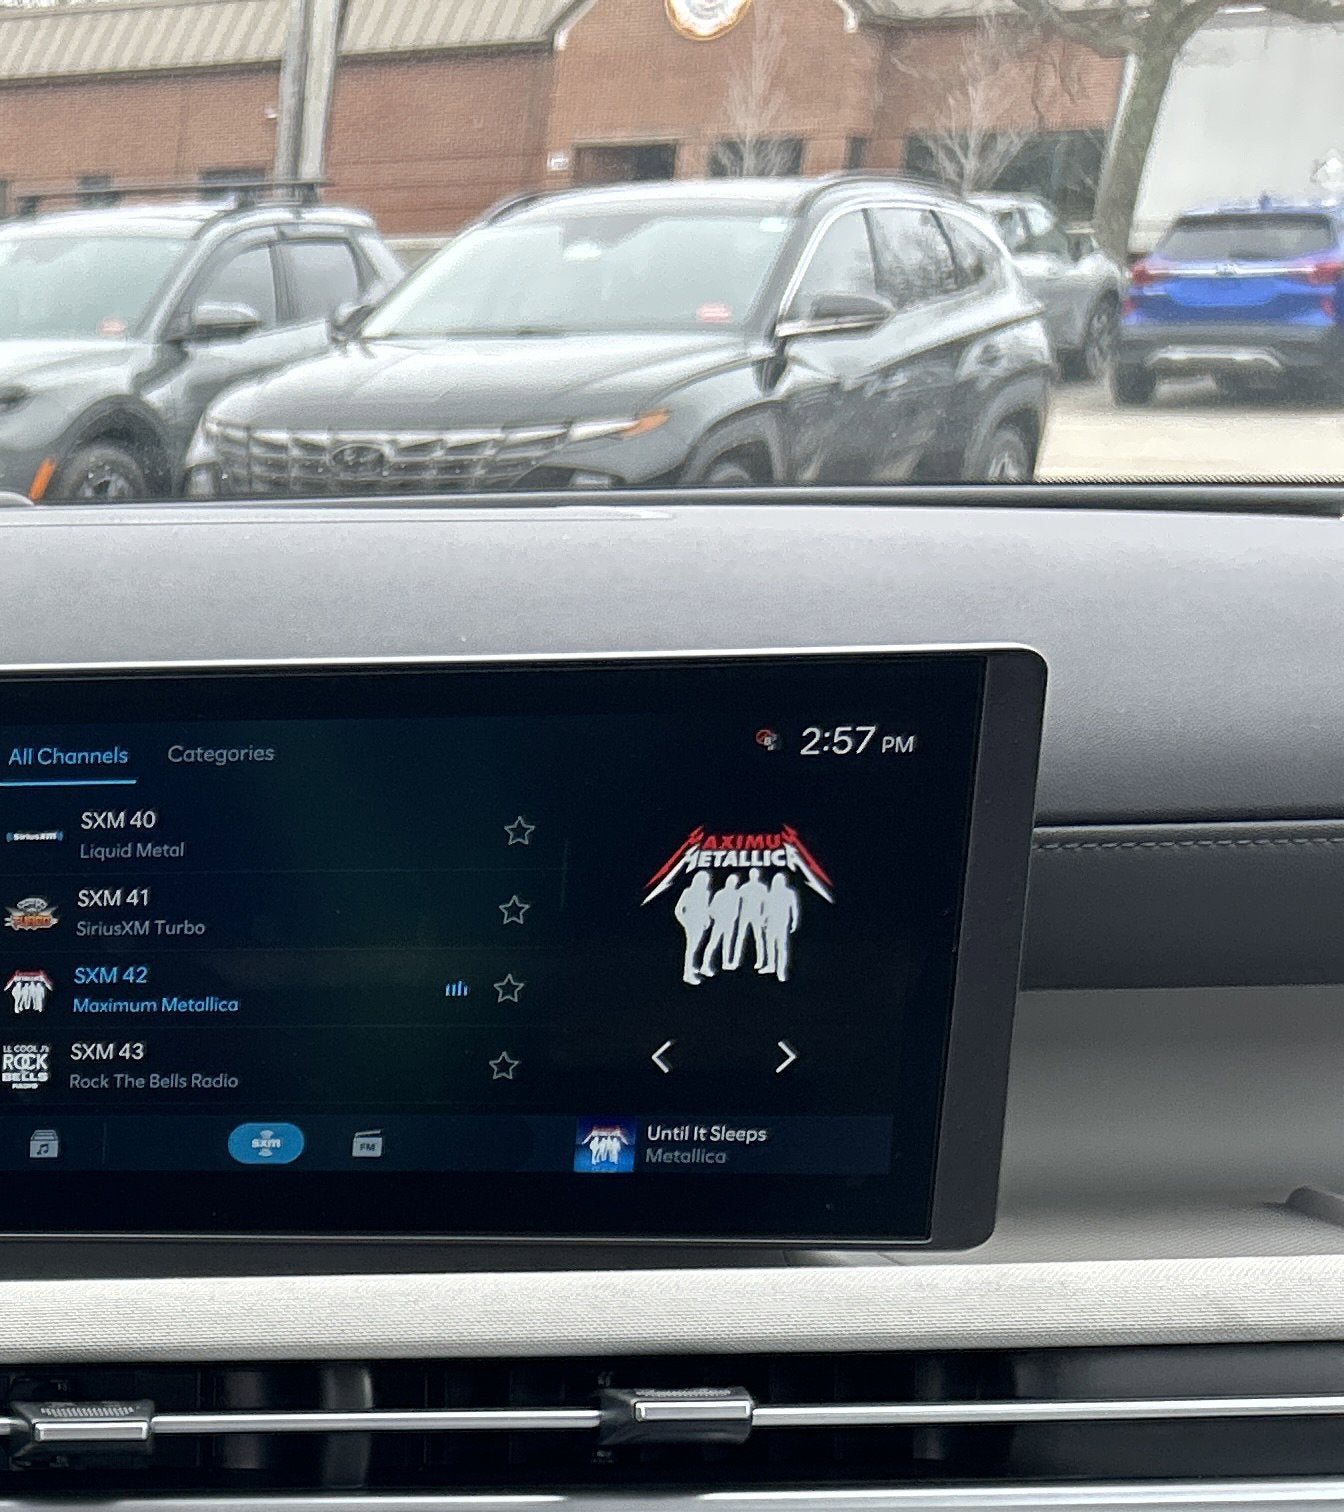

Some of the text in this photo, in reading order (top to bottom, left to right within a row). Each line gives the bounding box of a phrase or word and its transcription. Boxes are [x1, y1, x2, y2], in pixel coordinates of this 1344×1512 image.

[800, 726, 914, 754] 2:57 PM
[9, 747, 128, 765] All Channels
[168, 745, 274, 765] Categories
[81, 811, 155, 829] SXM 40
[81, 842, 184, 861] Liquid Metal
[78, 889, 148, 907] SXM 41
[76, 919, 206, 936] SiriusXM Turbo
[74, 967, 147, 984] SXM 42
[74, 997, 238, 1012] Maximum Metallica
[71, 1043, 143, 1060] SXM 43
[3, 1054, 49, 1070] ROCK
[2, 1073, 49, 1082] BELLS
[70, 1073, 238, 1088] Rock The Bells Radio
[648, 1125, 767, 1144] Until It Sleeps
[360, 1143, 376, 1151] FM
[646, 1148, 726, 1163] Metallica
